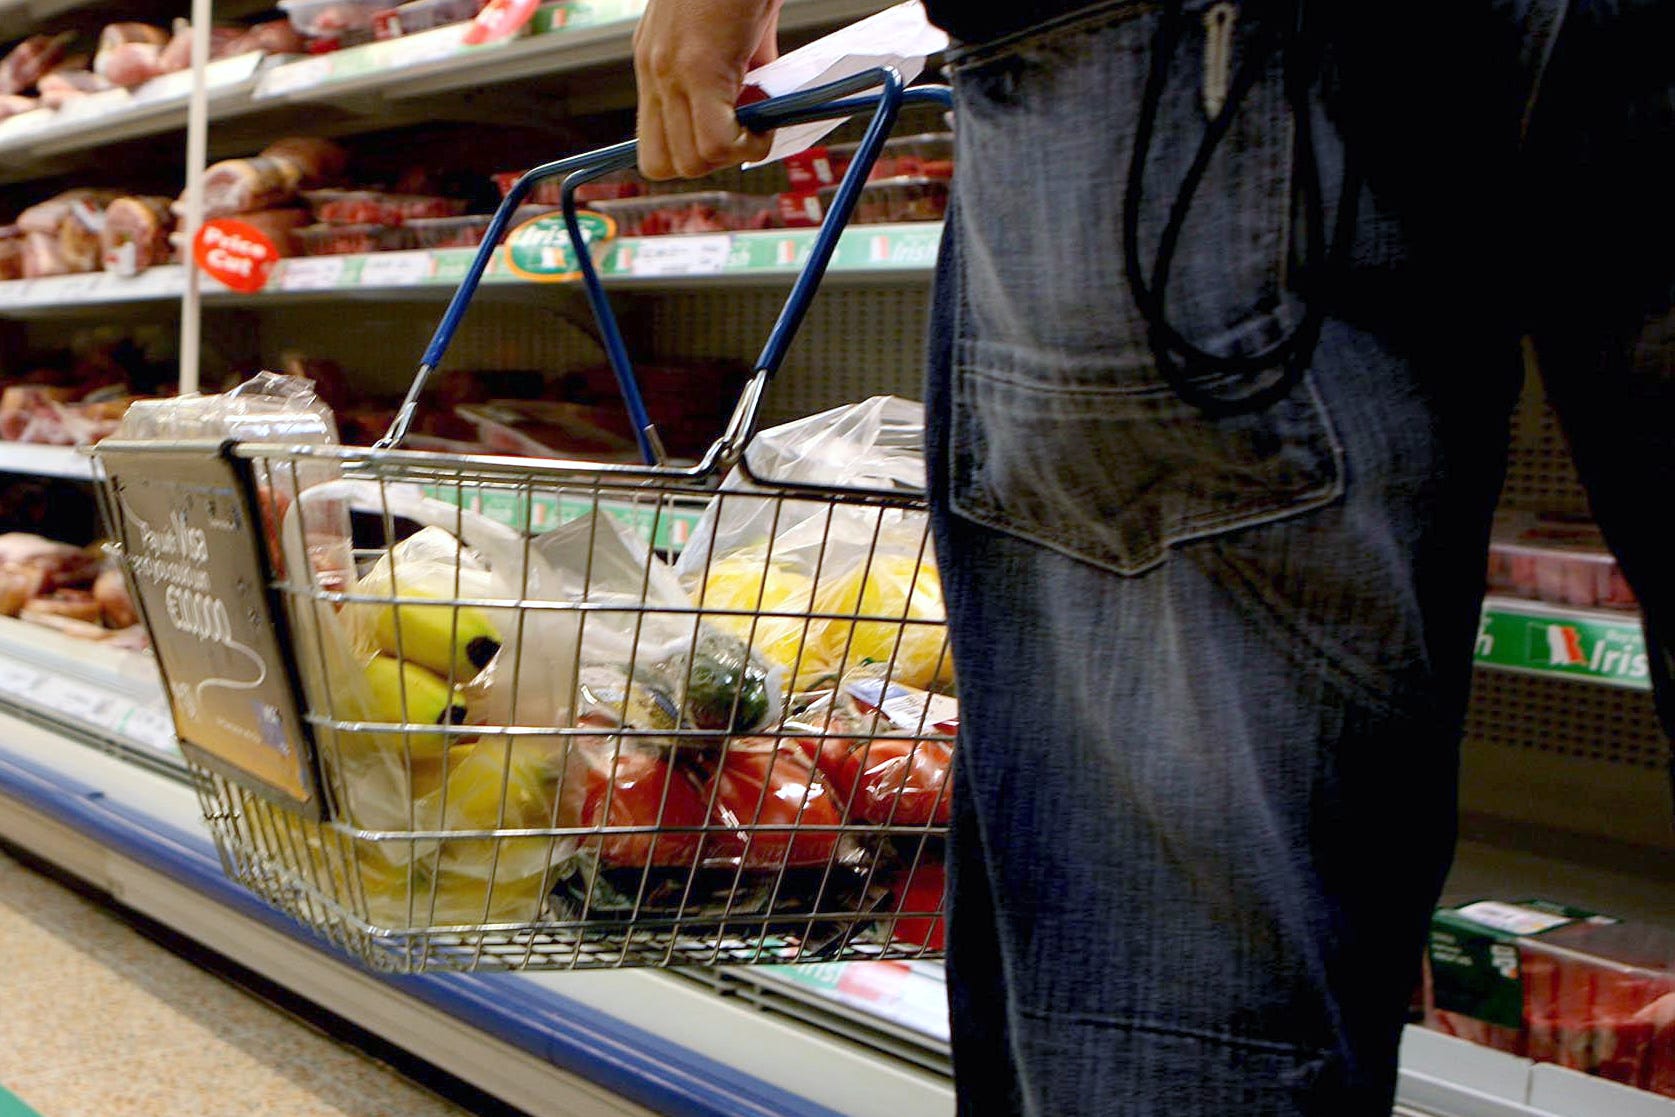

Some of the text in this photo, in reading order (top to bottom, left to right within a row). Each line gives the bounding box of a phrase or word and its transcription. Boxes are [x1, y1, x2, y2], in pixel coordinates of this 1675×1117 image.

[202, 225, 267, 260] Price
[206, 247, 253, 277] Cut
[1589, 639, 1649, 677] Iris
